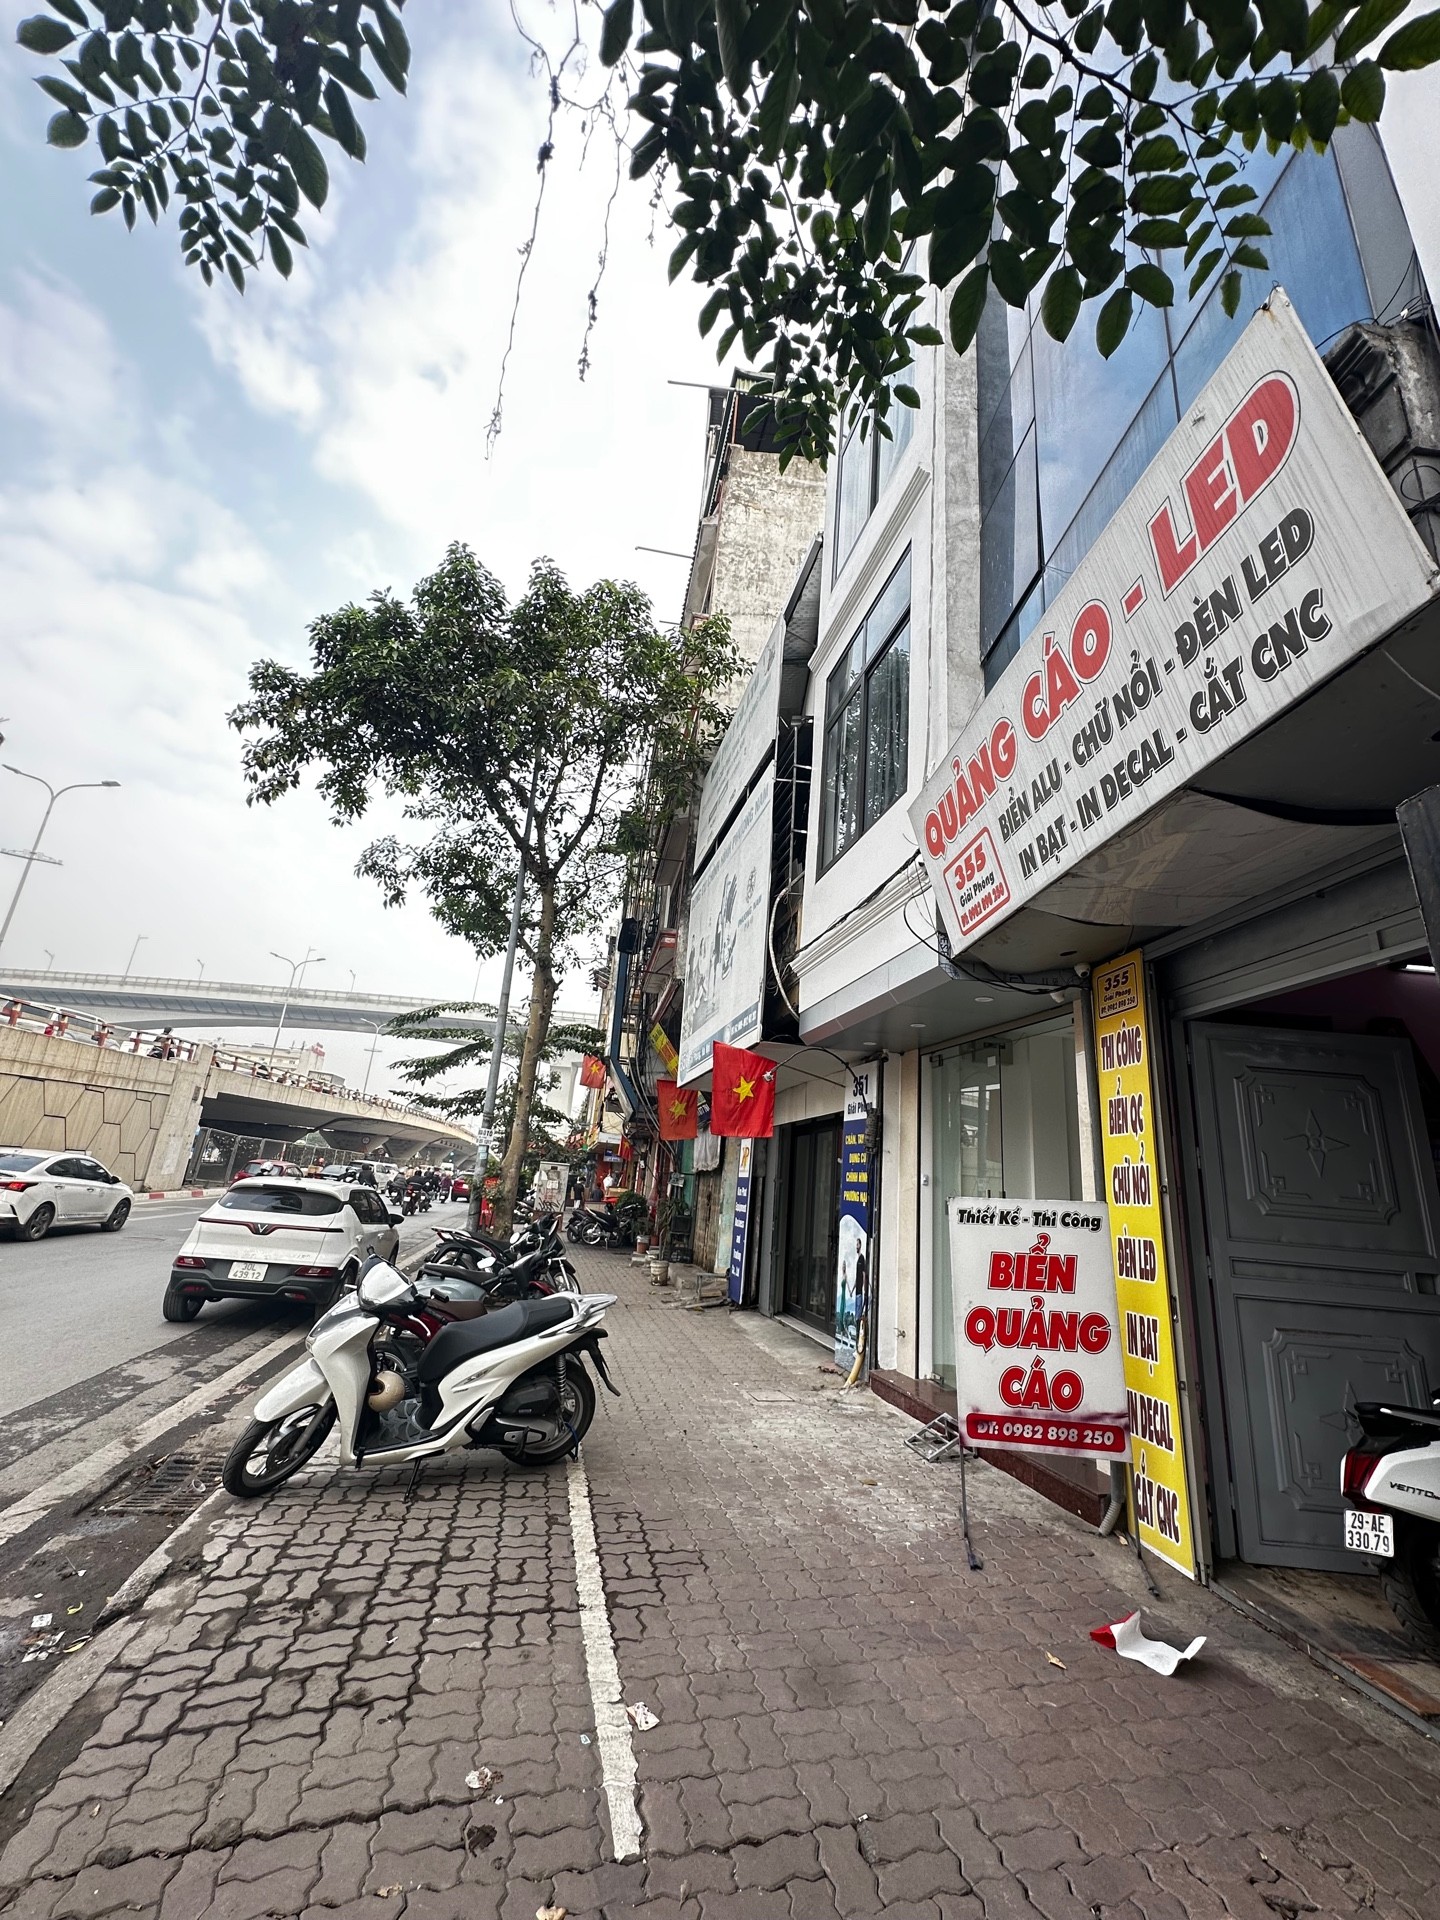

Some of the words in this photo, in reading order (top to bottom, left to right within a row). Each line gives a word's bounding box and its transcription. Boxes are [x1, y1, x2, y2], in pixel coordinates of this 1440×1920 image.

[925, 717, 1018, 859] QUẢNG
[1021, 599, 1113, 742] CÁO
[1146, 370, 1301, 601] LED
[999, 787, 1030, 842] BIỂN
[1032, 758, 1062, 812] ALU
[1072, 697, 1113, 768] CHỮ
[1114, 650, 1162, 730] NỔI
[1175, 574, 1243, 669] ĐÈN
[1241, 508, 1315, 604] LED
[1019, 849, 1038, 880] IN
[1039, 814, 1068, 863] BẠT
[1077, 786, 1102, 831] IN
[1100, 728, 1174, 811] DECAL
[1190, 655, 1248, 734] CẮT
[1251, 588, 1333, 682] CNC
[954, 841, 987, 891] 355
[960, 886, 973, 907] Giải
[973, 871, 995, 898] Phóng
[1104, 969, 1129, 992] 355
[1100, 1033, 1115, 1071] THI
[1116, 1019, 1142, 1068] CÔNG
[853, 1074, 869, 1097] 351
[1108, 1074, 1129, 1135] BIỂN
[1130, 1092, 1144, 1139] QC
[1113, 1155, 1131, 1206] CHỮ
[1131, 1141, 1151, 1206] NỔI
[958, 1205, 996, 1225] Thiết
[999, 1205, 1022, 1226] Kế
[1032, 1210, 1057, 1228] Thi
[1060, 1211, 1103, 1232] Công
[233, 1269, 261, 1280] 439.12
[242, 1263, 257, 1271] 30L
[988, 1232, 1078, 1294] BIỂN
[1117, 1226, 1137, 1279] ĐÈN
[1138, 1238, 1157, 1282] LED
[964, 1295, 1111, 1354] QUẢNG
[1126, 1311, 1139, 1357] IN
[1139, 1313, 1159, 1376] BẠT
[999, 1354, 1084, 1412] CÁO
[976, 1420, 999, 1435] ĐT:
[1002, 1422, 1044, 1439] 0982
[1048, 1427, 1078, 1442] 898
[1083, 1430, 1114, 1446] 250
[1127, 1388, 1139, 1437] IN
[1139, 1393, 1175, 1453] DECAL
[1135, 1449, 1154, 1529] CẮT
[1156, 1483, 1180, 1544] CNC
[1351, 1512, 1385, 1533] 29-AE
[1347, 1530, 1390, 1553] 330.79
